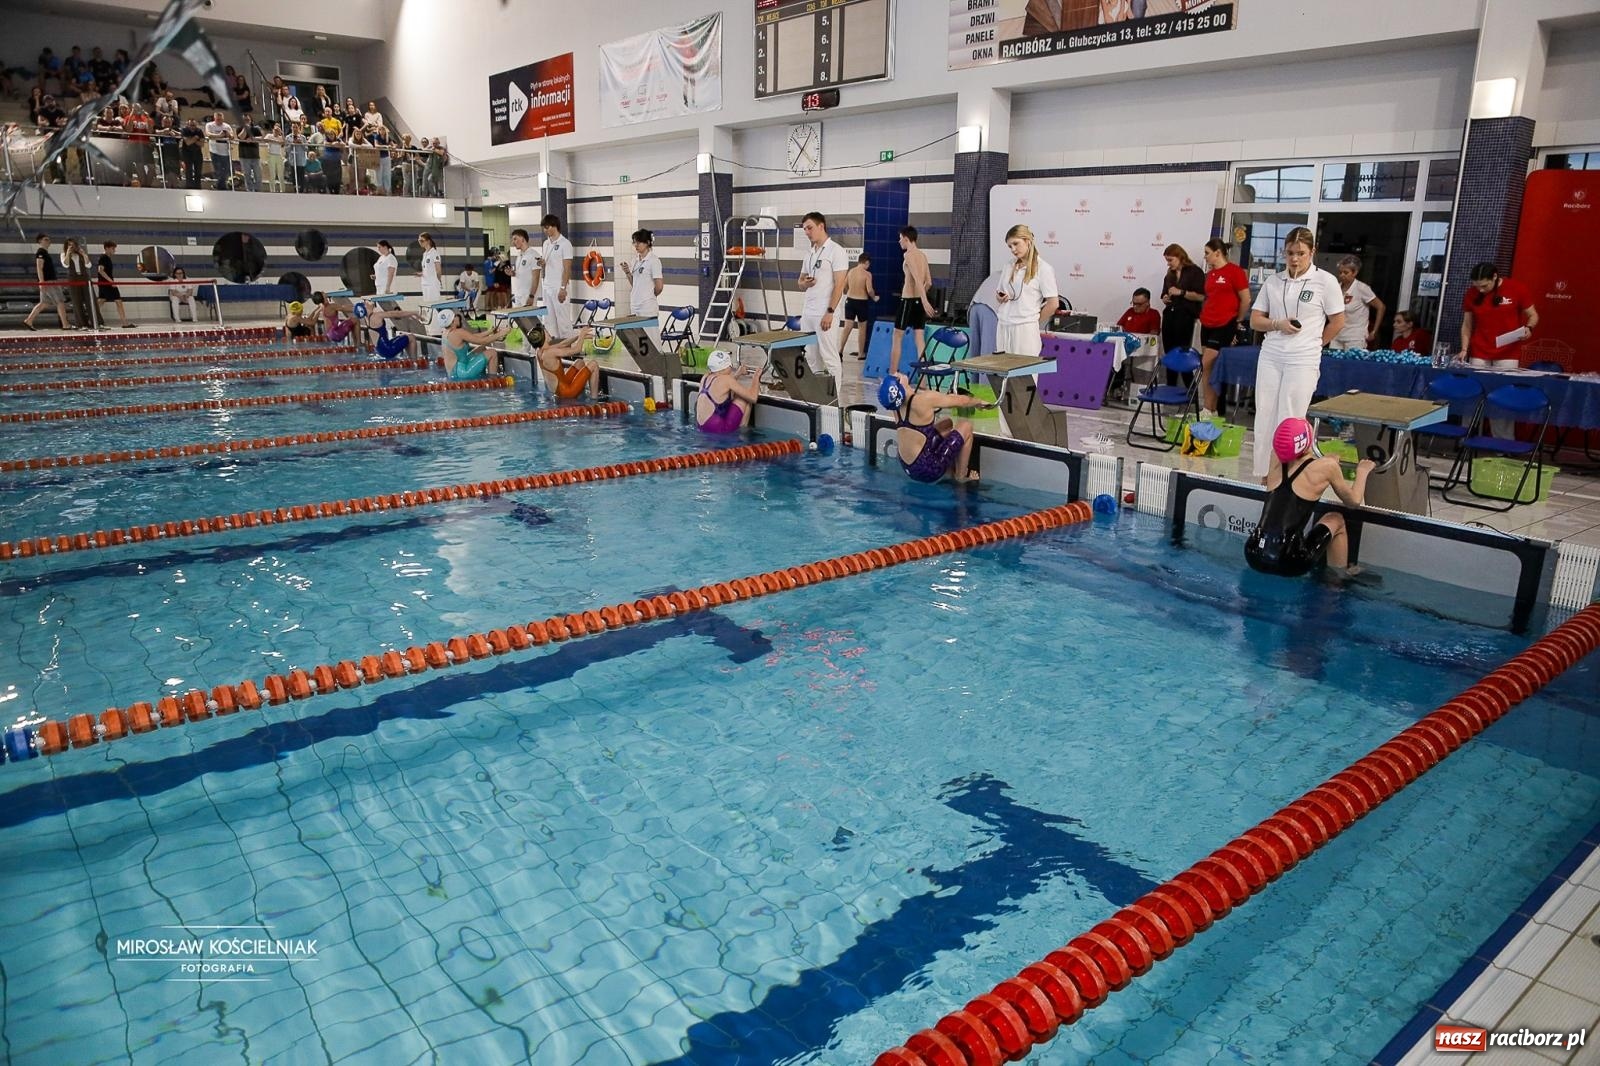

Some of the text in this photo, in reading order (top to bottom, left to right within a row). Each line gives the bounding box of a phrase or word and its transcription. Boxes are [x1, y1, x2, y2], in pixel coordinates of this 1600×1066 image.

[821, 16, 830, 26] 5.
[970, 12, 995, 27] DRZWI
[758, 31, 765, 40] 1.
[821, 34, 829, 45] 6.
[965, 29, 994, 45] PANELE
[1002, 37, 1052, 58] RACIBÓRZ
[1056, 40, 1067, 50] ul.
[1120, 28, 1134, 41] 13,
[1154, 23, 1167, 36] 32
[1175, 18, 1194, 32] 415
[1197, 16, 1210, 29] 25
[1213, 13, 1227, 27] 00
[758, 49, 765, 58] 2.
[821, 53, 829, 63] 7.
[972, 47, 993, 60] OKNA
[758, 66, 765, 75] 3.
[820, 71, 828, 81] 8.
[758, 83, 765, 92] 4.
[530, 84, 571, 109] informacji
[511, 98, 523, 112] rtk
[638, 336, 649, 357] 5
[795, 355, 804, 379] 6
[1026, 385, 1036, 415] 7
[1400, 437, 1411, 476] 8
